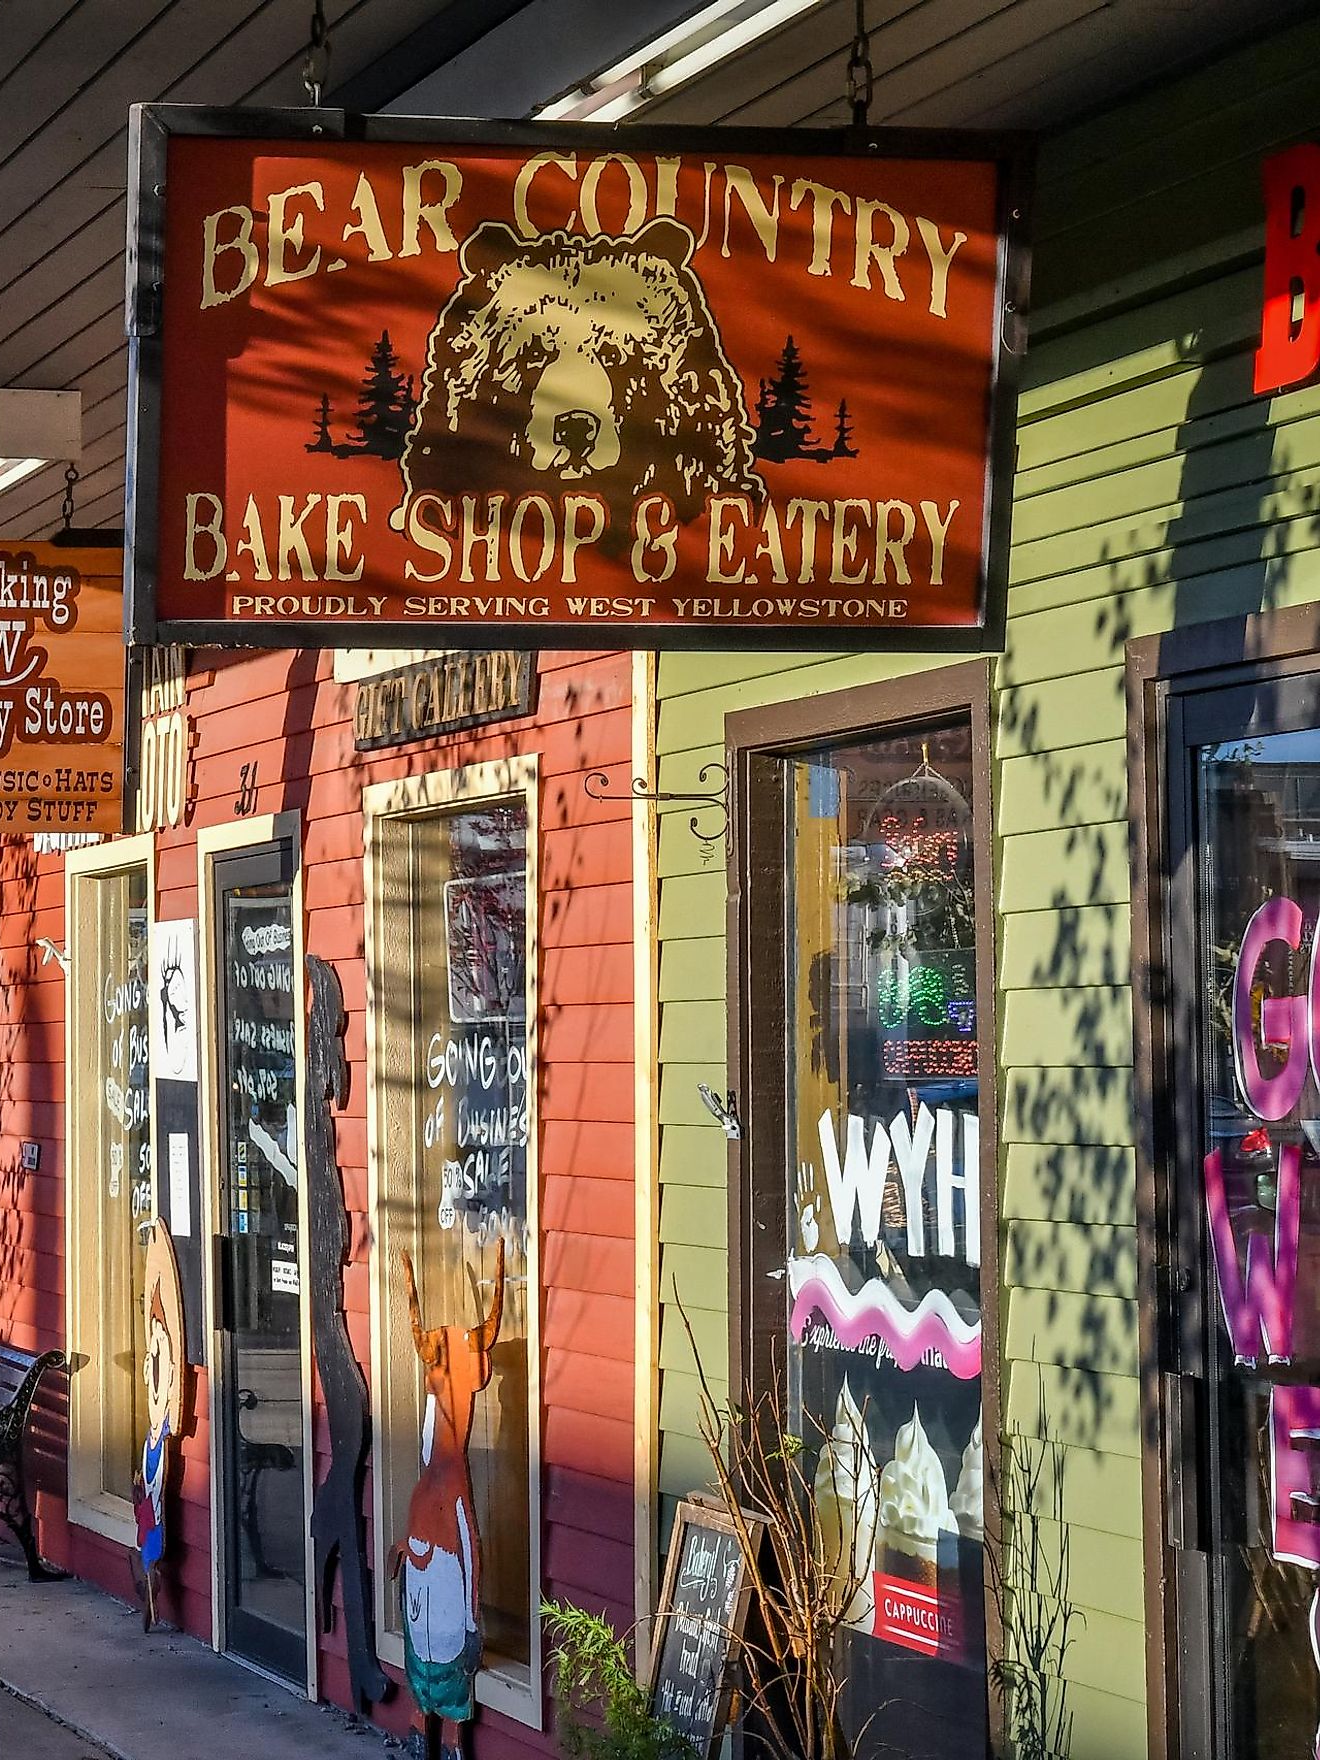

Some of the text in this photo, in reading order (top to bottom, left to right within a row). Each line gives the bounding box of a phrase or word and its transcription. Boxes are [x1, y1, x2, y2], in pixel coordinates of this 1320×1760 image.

[198, 152, 968, 319] BEAR COUNTRY
[183, 492, 961, 588] BAKE SHOP & EATERY
[232, 596, 909, 619] PROUDLY SERVING WEST YELLOWSTONE
[25, 687, 105, 736] Store
[354, 650, 523, 741] GIFT GALLERY
[55, 768, 114, 793] HATS
[26, 797, 99, 823] STUFF
[427, 1033, 496, 1090] GOING
[463, 1147, 510, 1200] SALE
